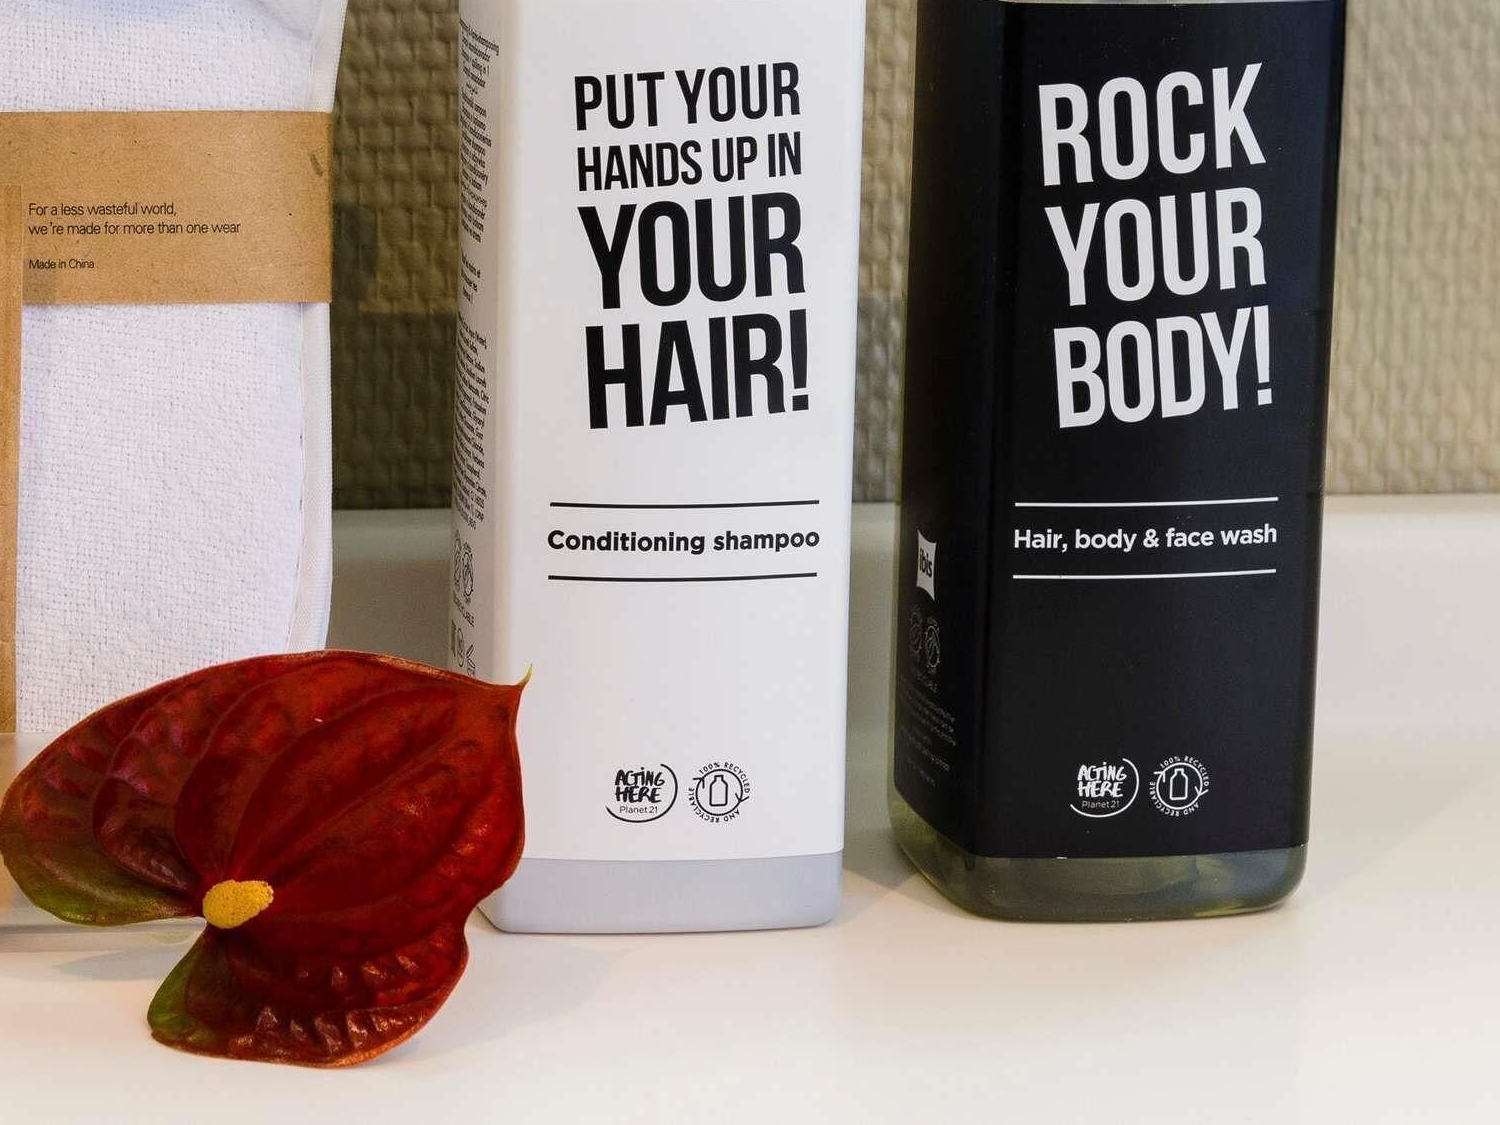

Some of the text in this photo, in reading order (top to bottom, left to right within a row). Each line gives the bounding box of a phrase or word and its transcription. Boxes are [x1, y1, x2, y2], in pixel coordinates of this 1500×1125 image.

[575, 62, 800, 130] PUT YOUR
[1039, 63, 1266, 186] ROCK
[578, 131, 801, 191] HANDS UP IN
[28, 201, 177, 217] For a less wasteful world,
[66, 222, 101, 235] made
[103, 221, 120, 235] for
[123, 224, 155, 235] more
[157, 221, 183, 235] than
[185, 223, 209, 235] one
[210, 223, 241, 234] wear
[578, 193, 805, 309] YOUR
[1045, 187, 1267, 306] YOUR
[28, 258, 95, 270] Made in China
[586, 309, 808, 429] HAIR!
[1054, 305, 1272, 428] BODY!
[548, 530, 819, 555] Conditioning shampoo
[1015, 524, 1276, 552] Hair, body & face wash
[919, 547, 933, 578] ibis
[699, 761, 751, 793] 100% RECYCLED
[1160, 755, 1210, 787] 100% RECYCLED
[615, 786, 662, 803] HERE
[1077, 780, 1124, 798] HERE
[1081, 800, 1120, 809] Planet 21
[1149, 781, 1199, 817] AND RECYCLABLE
[619, 806, 658, 814] Planet 21
[688, 787, 740, 824] AND RECYCLABLE
